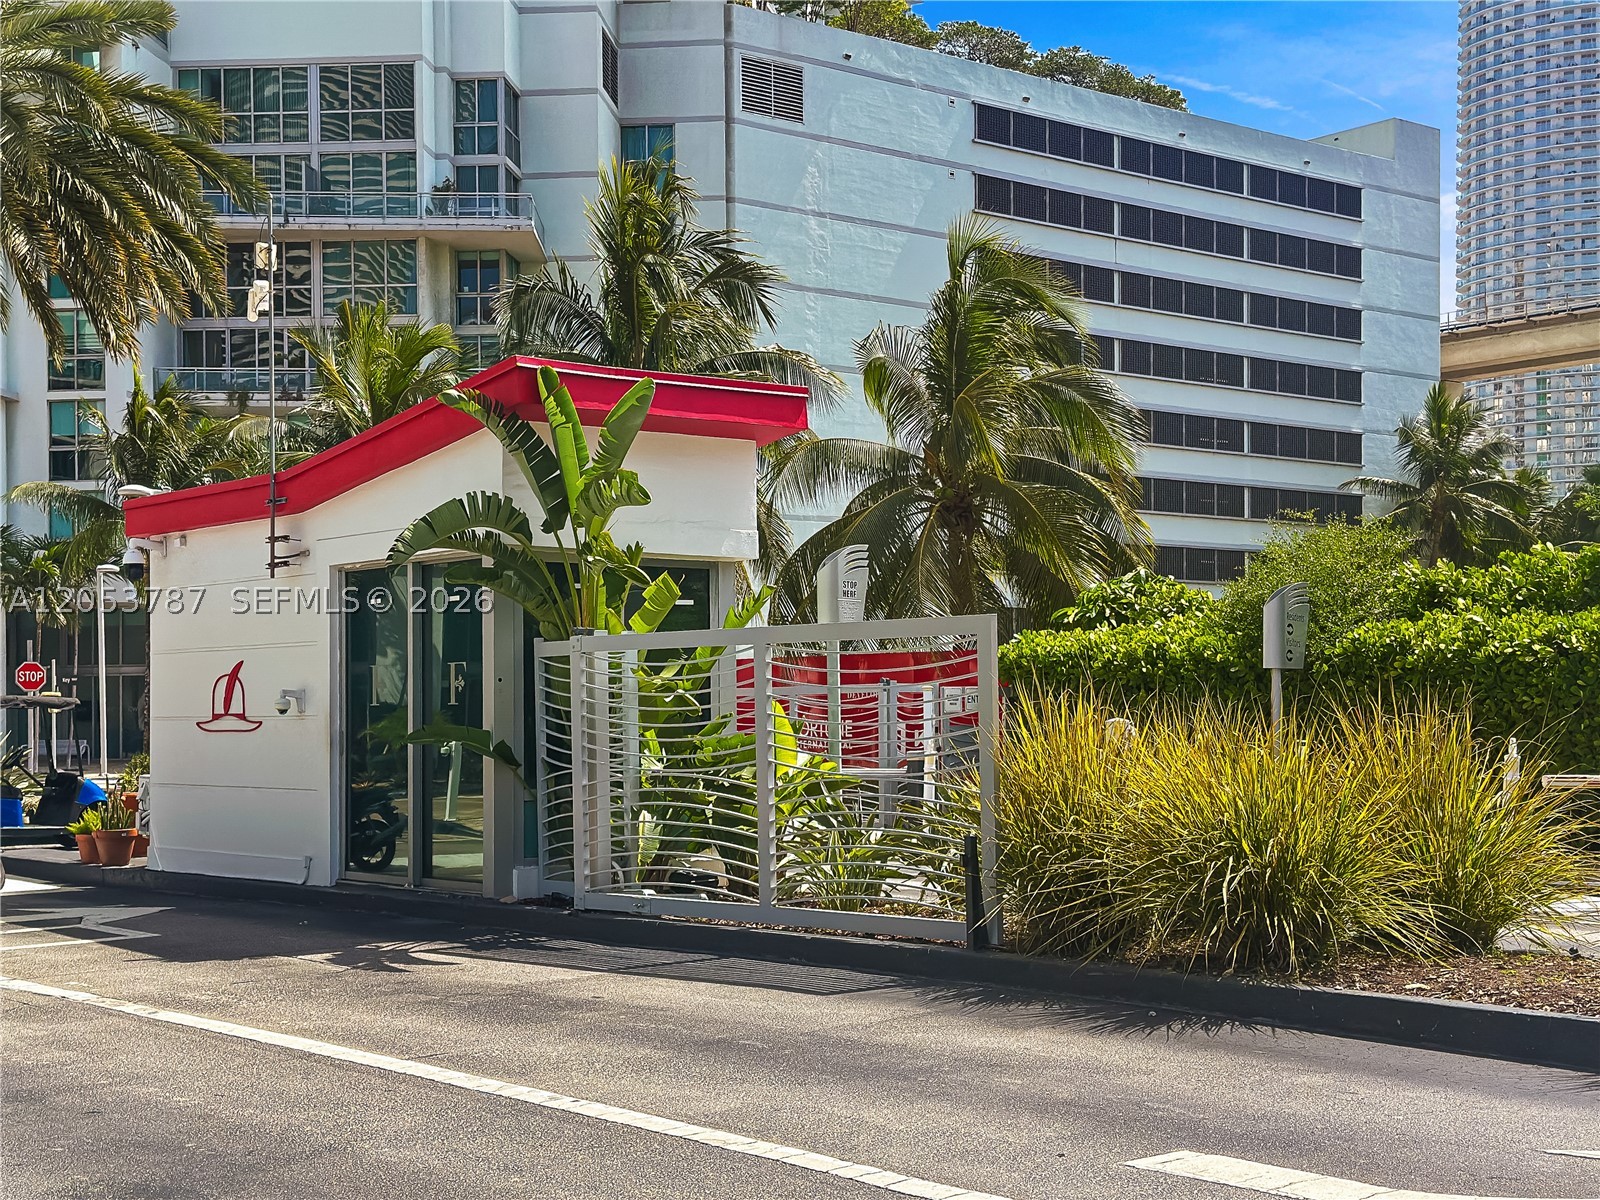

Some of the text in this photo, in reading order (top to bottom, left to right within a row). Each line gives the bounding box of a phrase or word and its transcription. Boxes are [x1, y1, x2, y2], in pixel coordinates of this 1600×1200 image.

[842, 580, 858, 589] STOP
[842, 590, 857, 598] HERE
[1286, 611, 1306, 622] Residents
[18, 670, 44, 682] STOP
